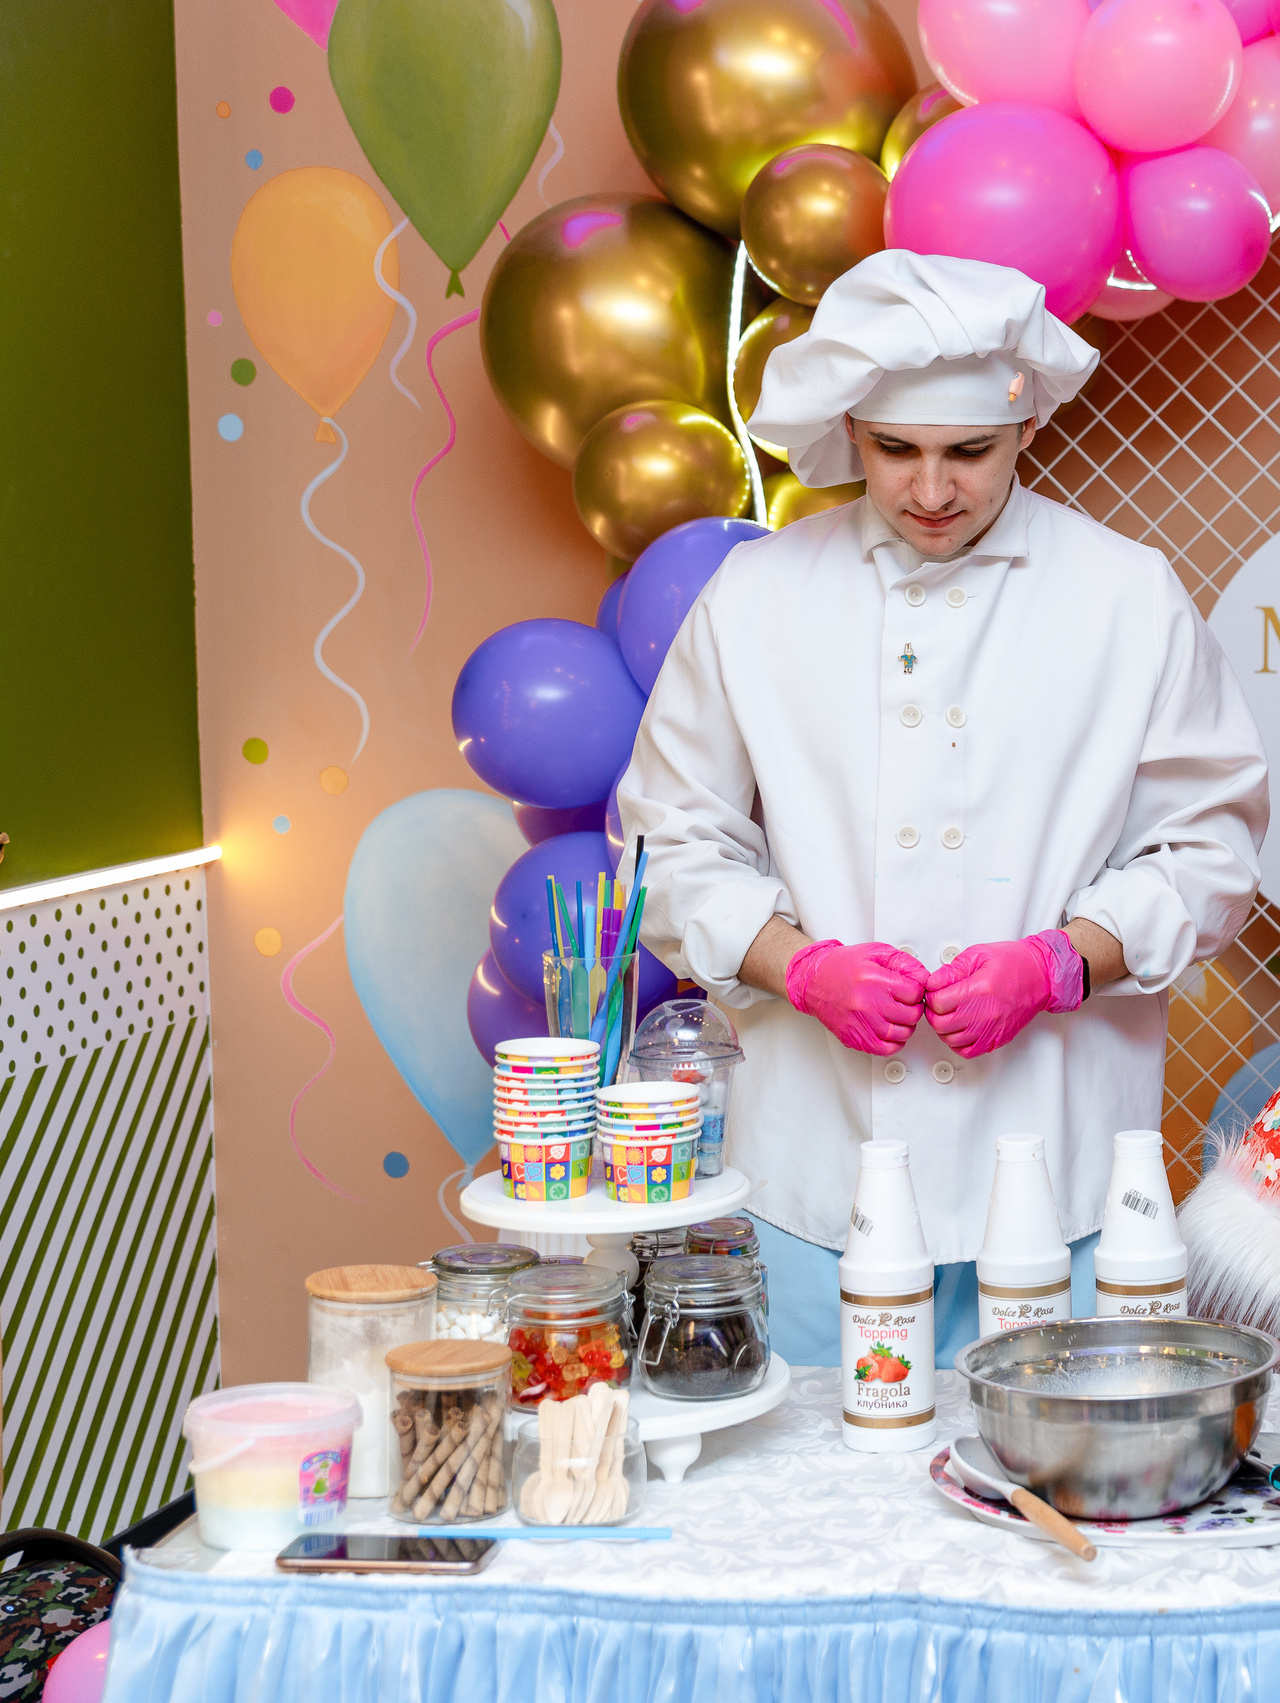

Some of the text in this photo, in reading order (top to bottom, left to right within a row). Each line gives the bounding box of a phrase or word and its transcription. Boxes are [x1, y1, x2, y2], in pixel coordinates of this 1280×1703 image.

[991, 1306, 1017, 1317] Dolce
[1033, 1306, 1054, 1318] Rosa
[1120, 1304, 1147, 1315] Dolce
[852, 1314, 877, 1326] Dolce
[893, 1315, 916, 1327] Rosa
[858, 1325, 908, 1341] Topping
[857, 1382, 911, 1401] Fragola
[857, 1399, 908, 1410] клубника
